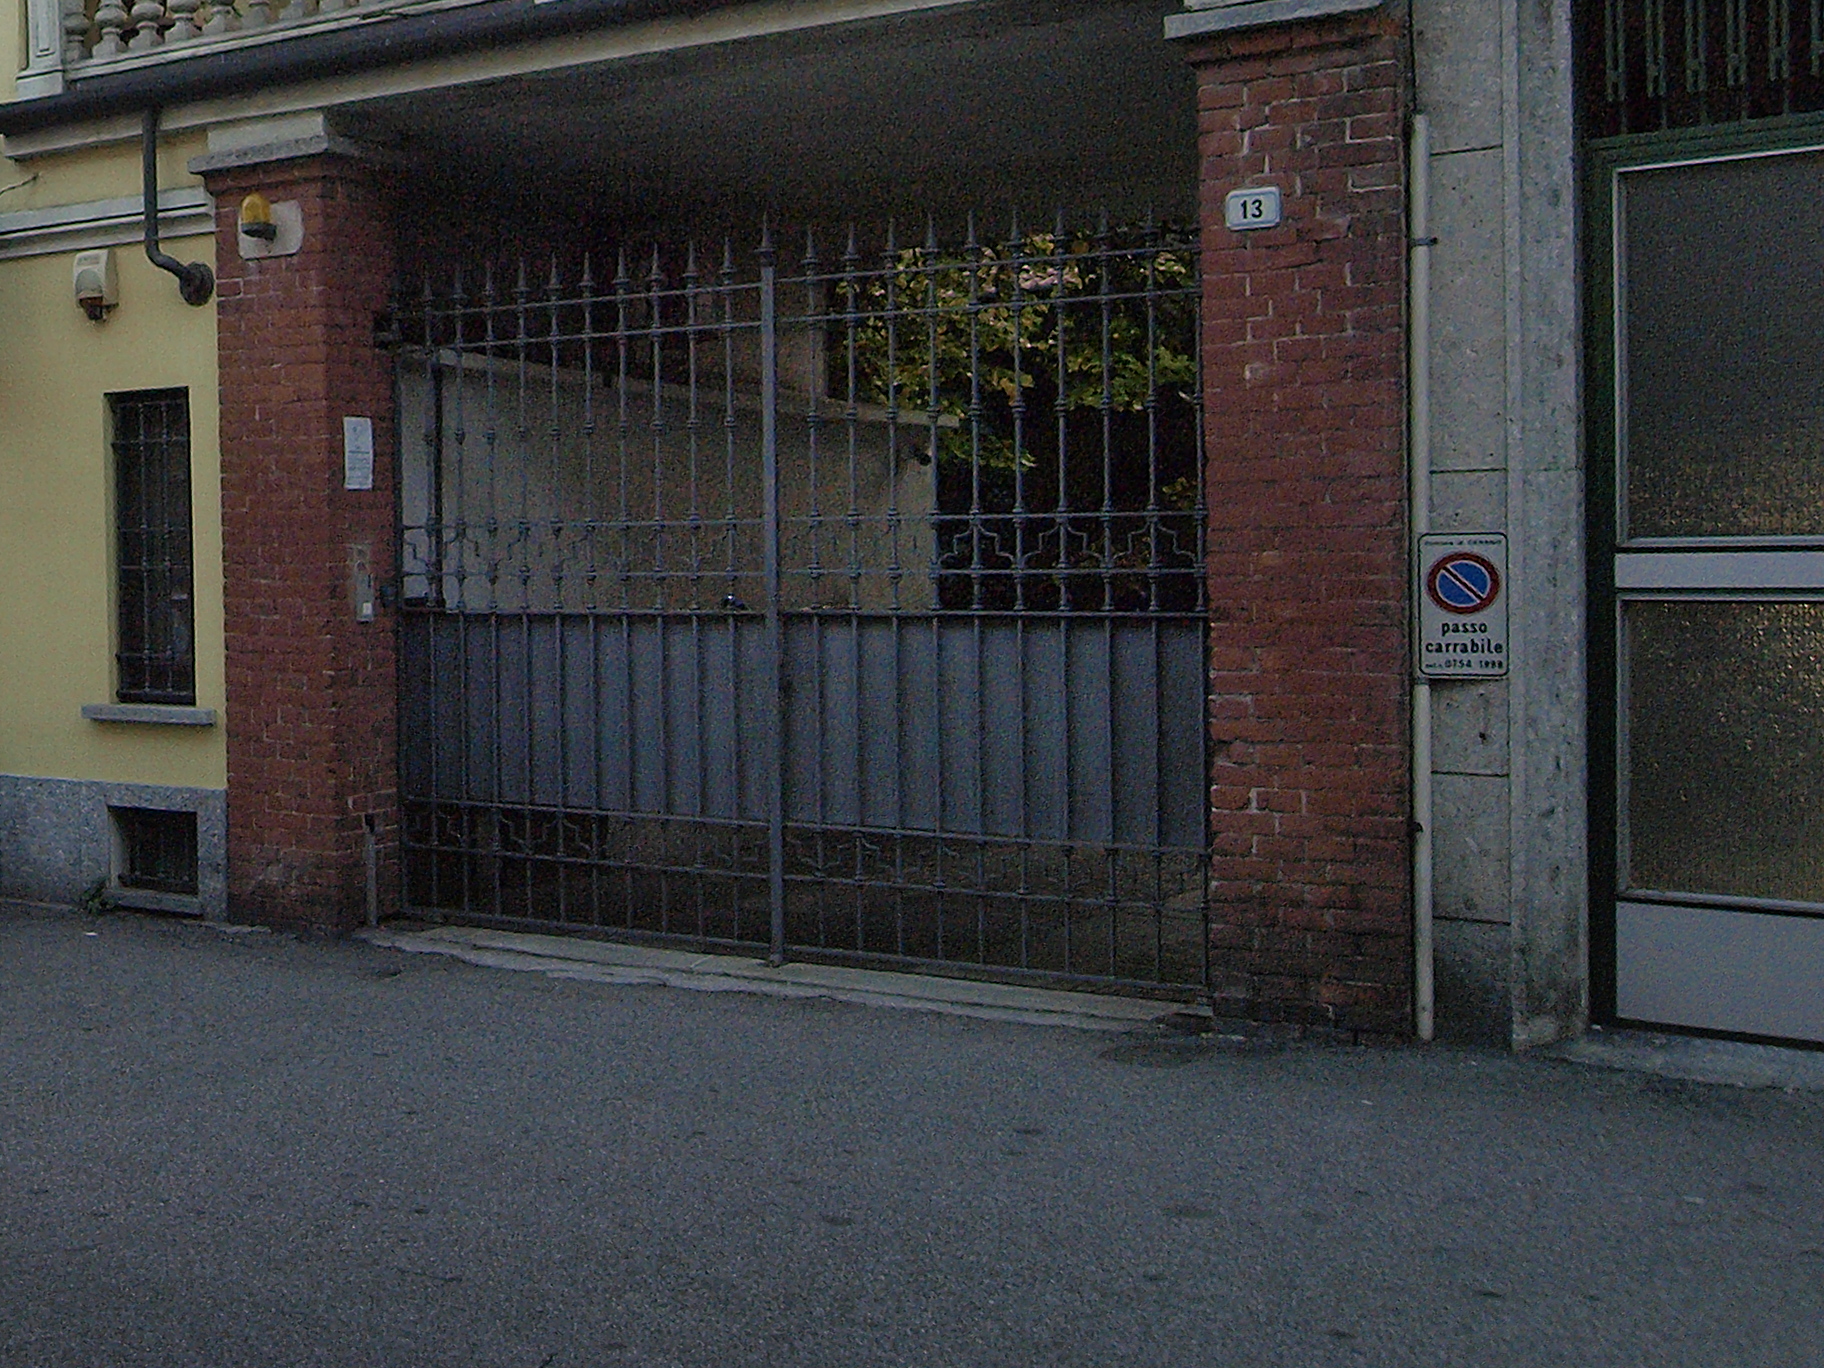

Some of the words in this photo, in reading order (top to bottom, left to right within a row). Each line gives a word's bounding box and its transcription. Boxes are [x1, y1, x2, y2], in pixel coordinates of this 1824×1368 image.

[1241, 200, 1263, 219] 13
[1441, 622, 1487, 637] passo
[1426, 638, 1503, 654] carrabile
